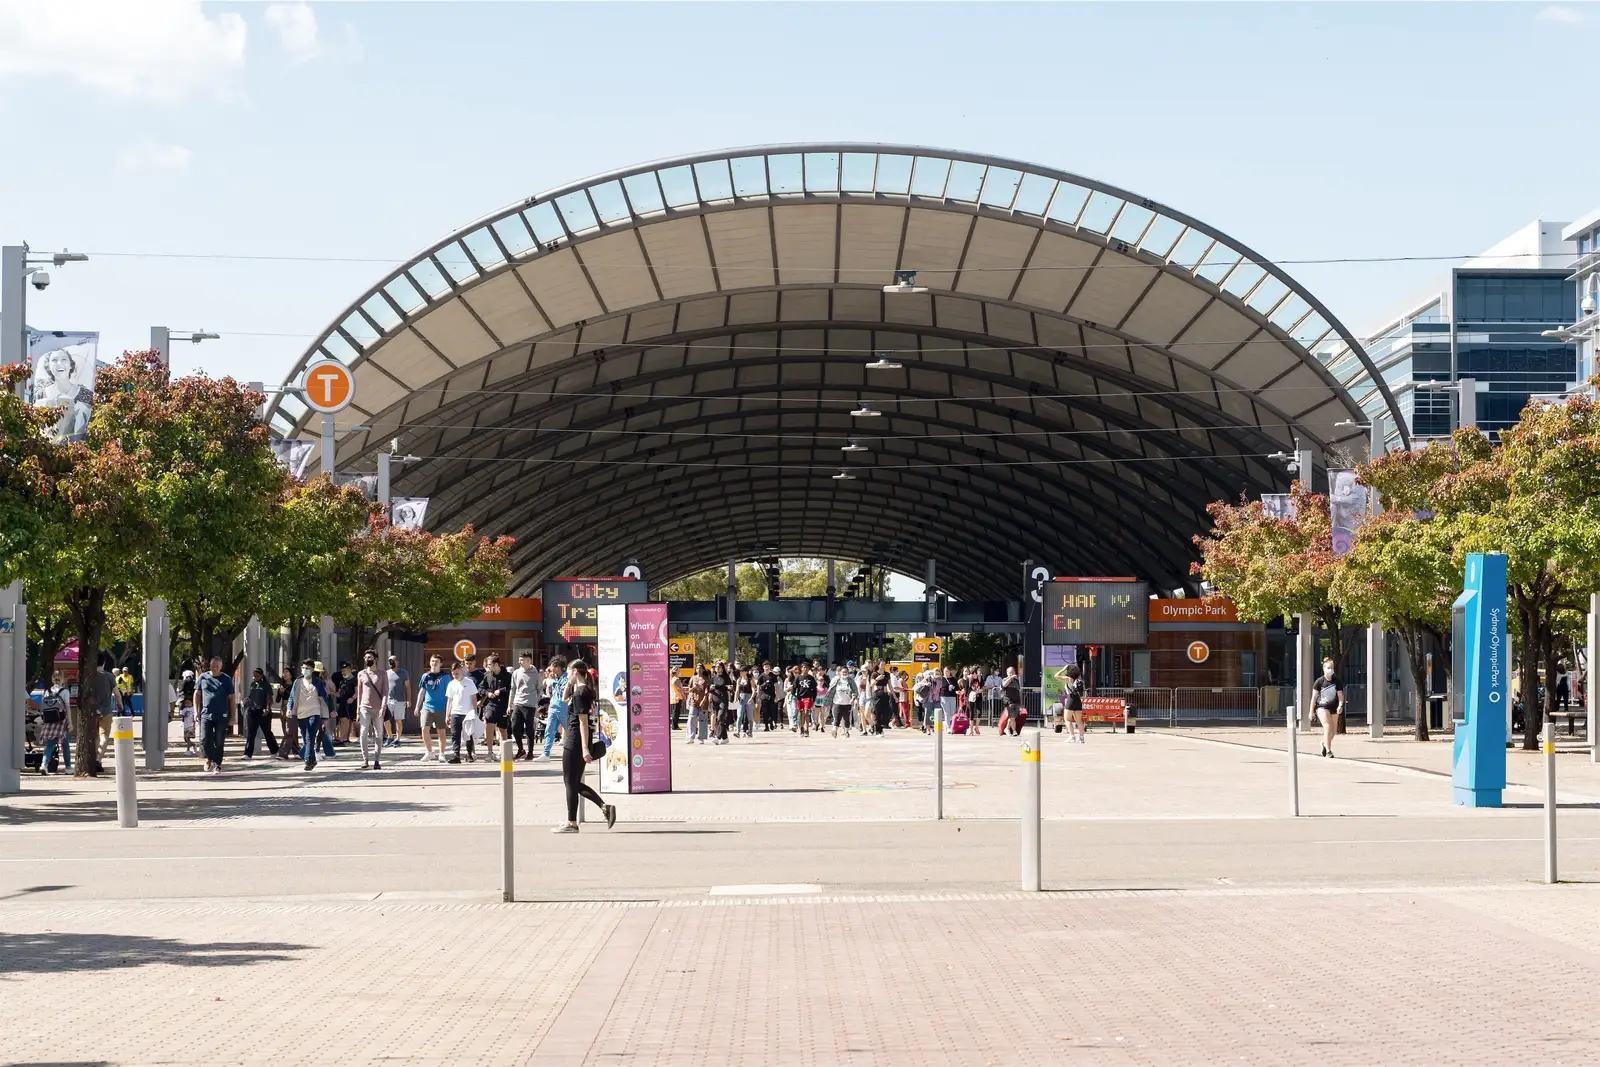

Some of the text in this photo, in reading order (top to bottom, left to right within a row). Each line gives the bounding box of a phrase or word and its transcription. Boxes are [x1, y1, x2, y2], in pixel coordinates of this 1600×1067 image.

[317, 374, 339, 402] T
[571, 584, 619, 599] City
[1162, 605, 1227, 617] Olympic Park
[630, 622, 655, 630] What's
[460, 645, 470, 658] T
[630, 641, 661, 650] Autumn
[1193, 646, 1203, 659] T
